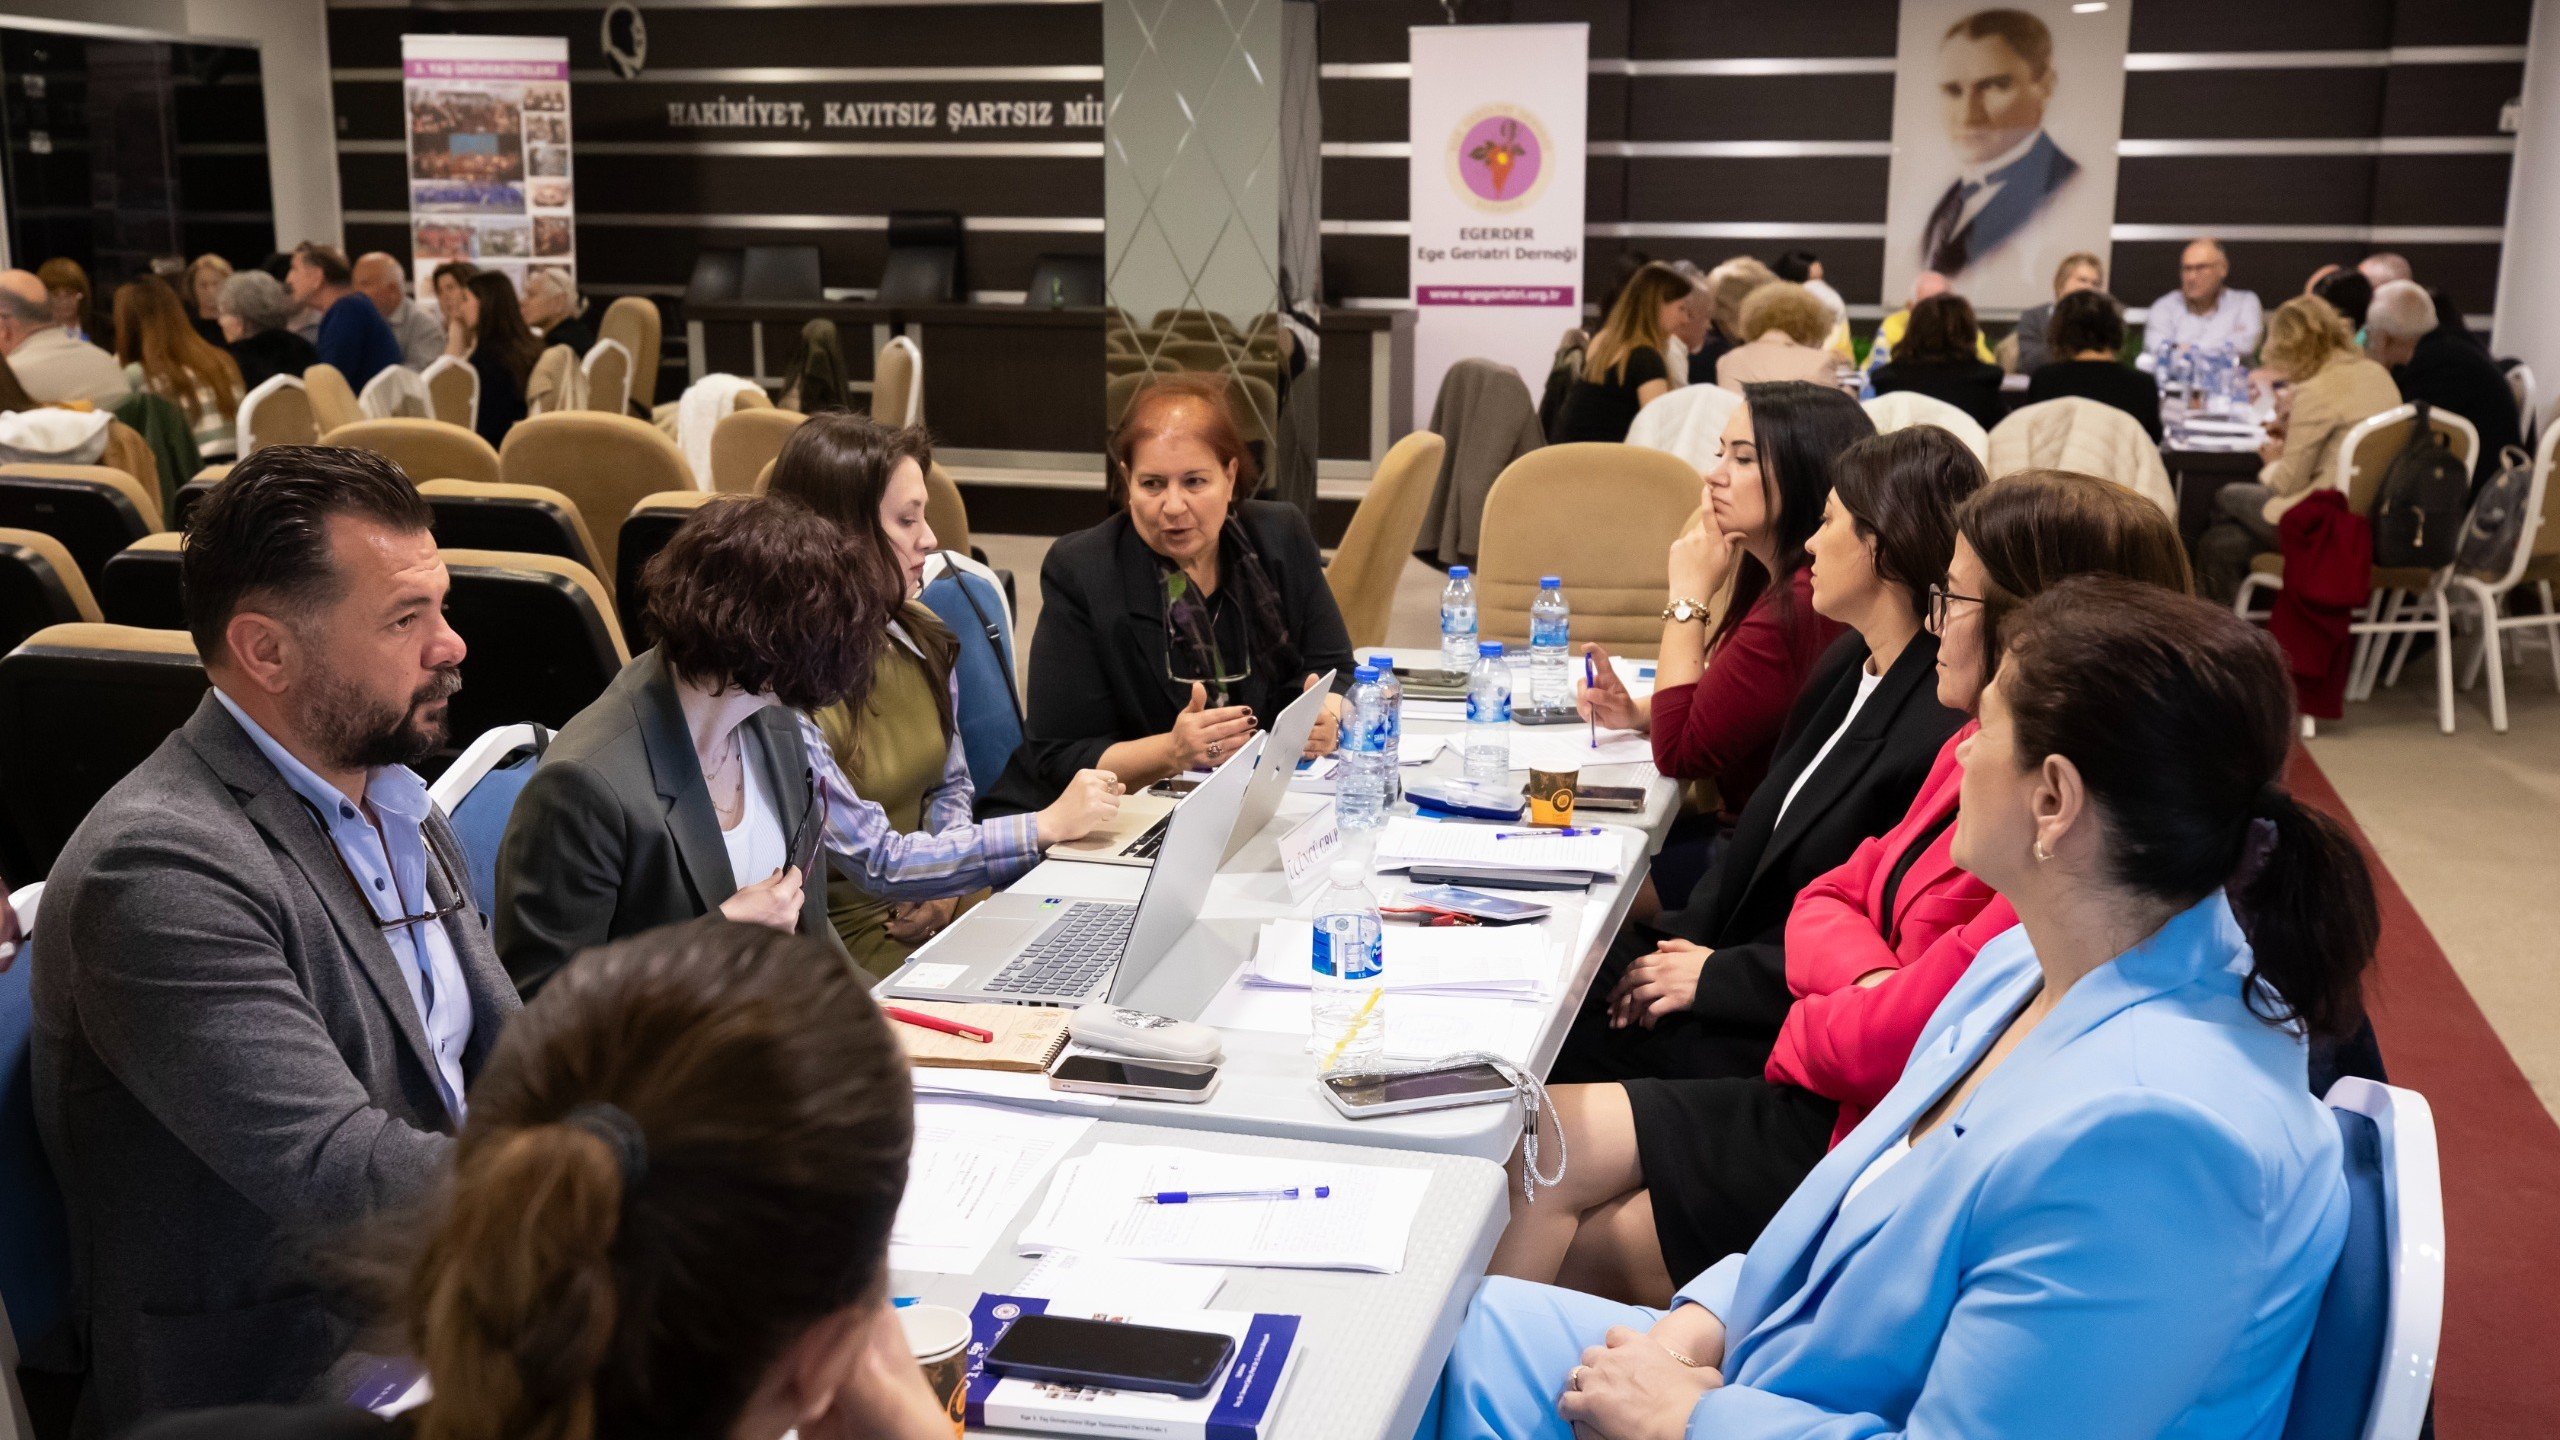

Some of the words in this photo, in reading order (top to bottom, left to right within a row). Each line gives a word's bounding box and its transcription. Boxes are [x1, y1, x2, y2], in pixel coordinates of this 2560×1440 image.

[667, 95, 811, 132] HAKİMİYET,
[823, 101, 937, 127] KAYITSIZ
[947, 101, 1053, 133] ŞARTSIZ
[1459, 227, 1535, 241] EGERDER
[1417, 247, 1446, 262] Ege
[1451, 246, 1510, 260] Geriatri
[1515, 246, 1578, 262] Derneği
